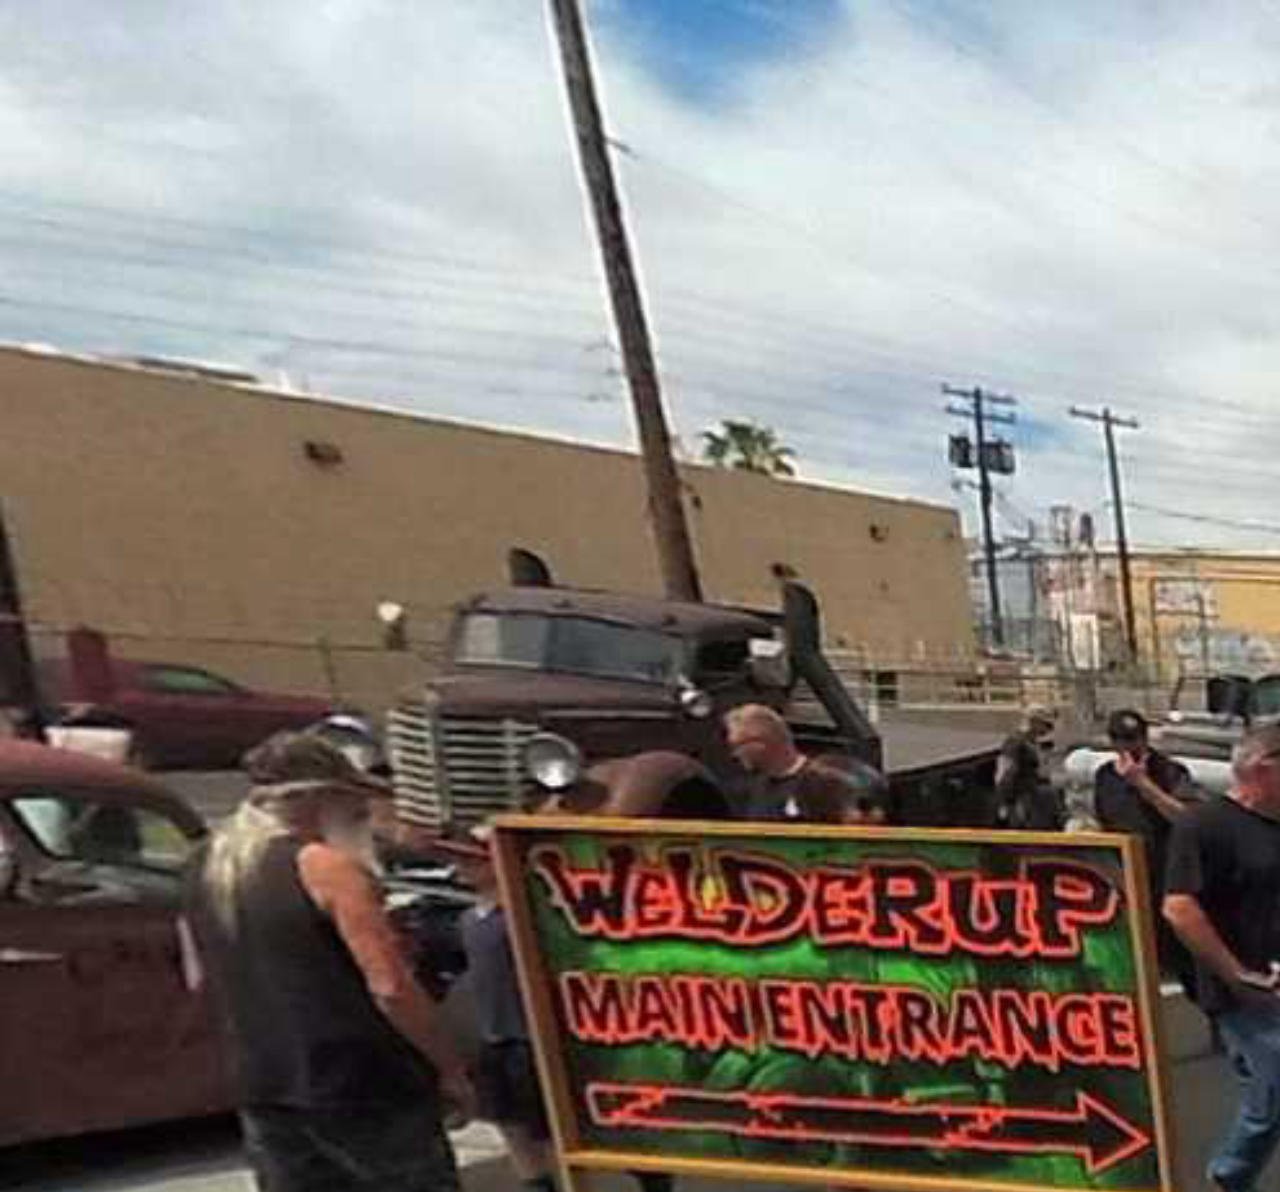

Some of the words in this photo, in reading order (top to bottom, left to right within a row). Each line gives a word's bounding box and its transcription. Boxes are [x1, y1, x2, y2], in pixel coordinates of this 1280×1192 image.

[534, 844, 1120, 956] WELDERUP
[564, 972, 758, 1049] MAIN
[761, 978, 1142, 1069] ENTRANCE
